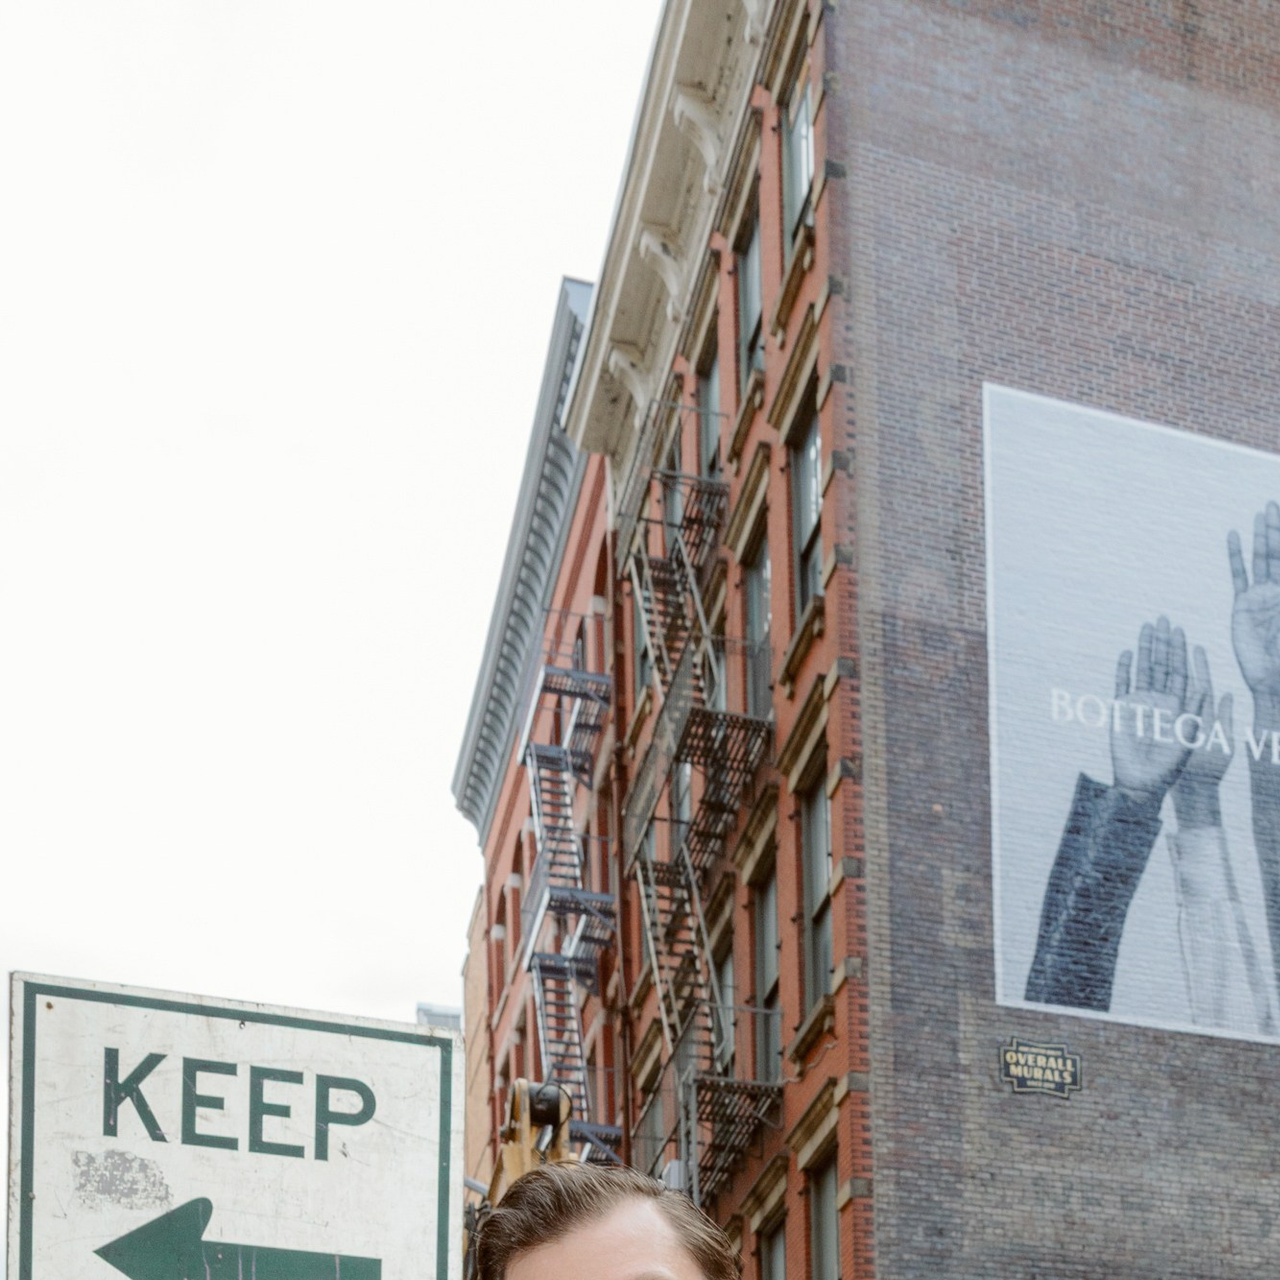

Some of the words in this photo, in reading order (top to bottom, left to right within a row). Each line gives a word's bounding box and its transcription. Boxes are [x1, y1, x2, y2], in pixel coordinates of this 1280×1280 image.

[1050, 687, 1231, 755] BOTTEGA
[1005, 1051, 1075, 1072] OVERALL
[1009, 1064, 1072, 1084] MURALS
[102, 1046, 377, 1161] KEEP
